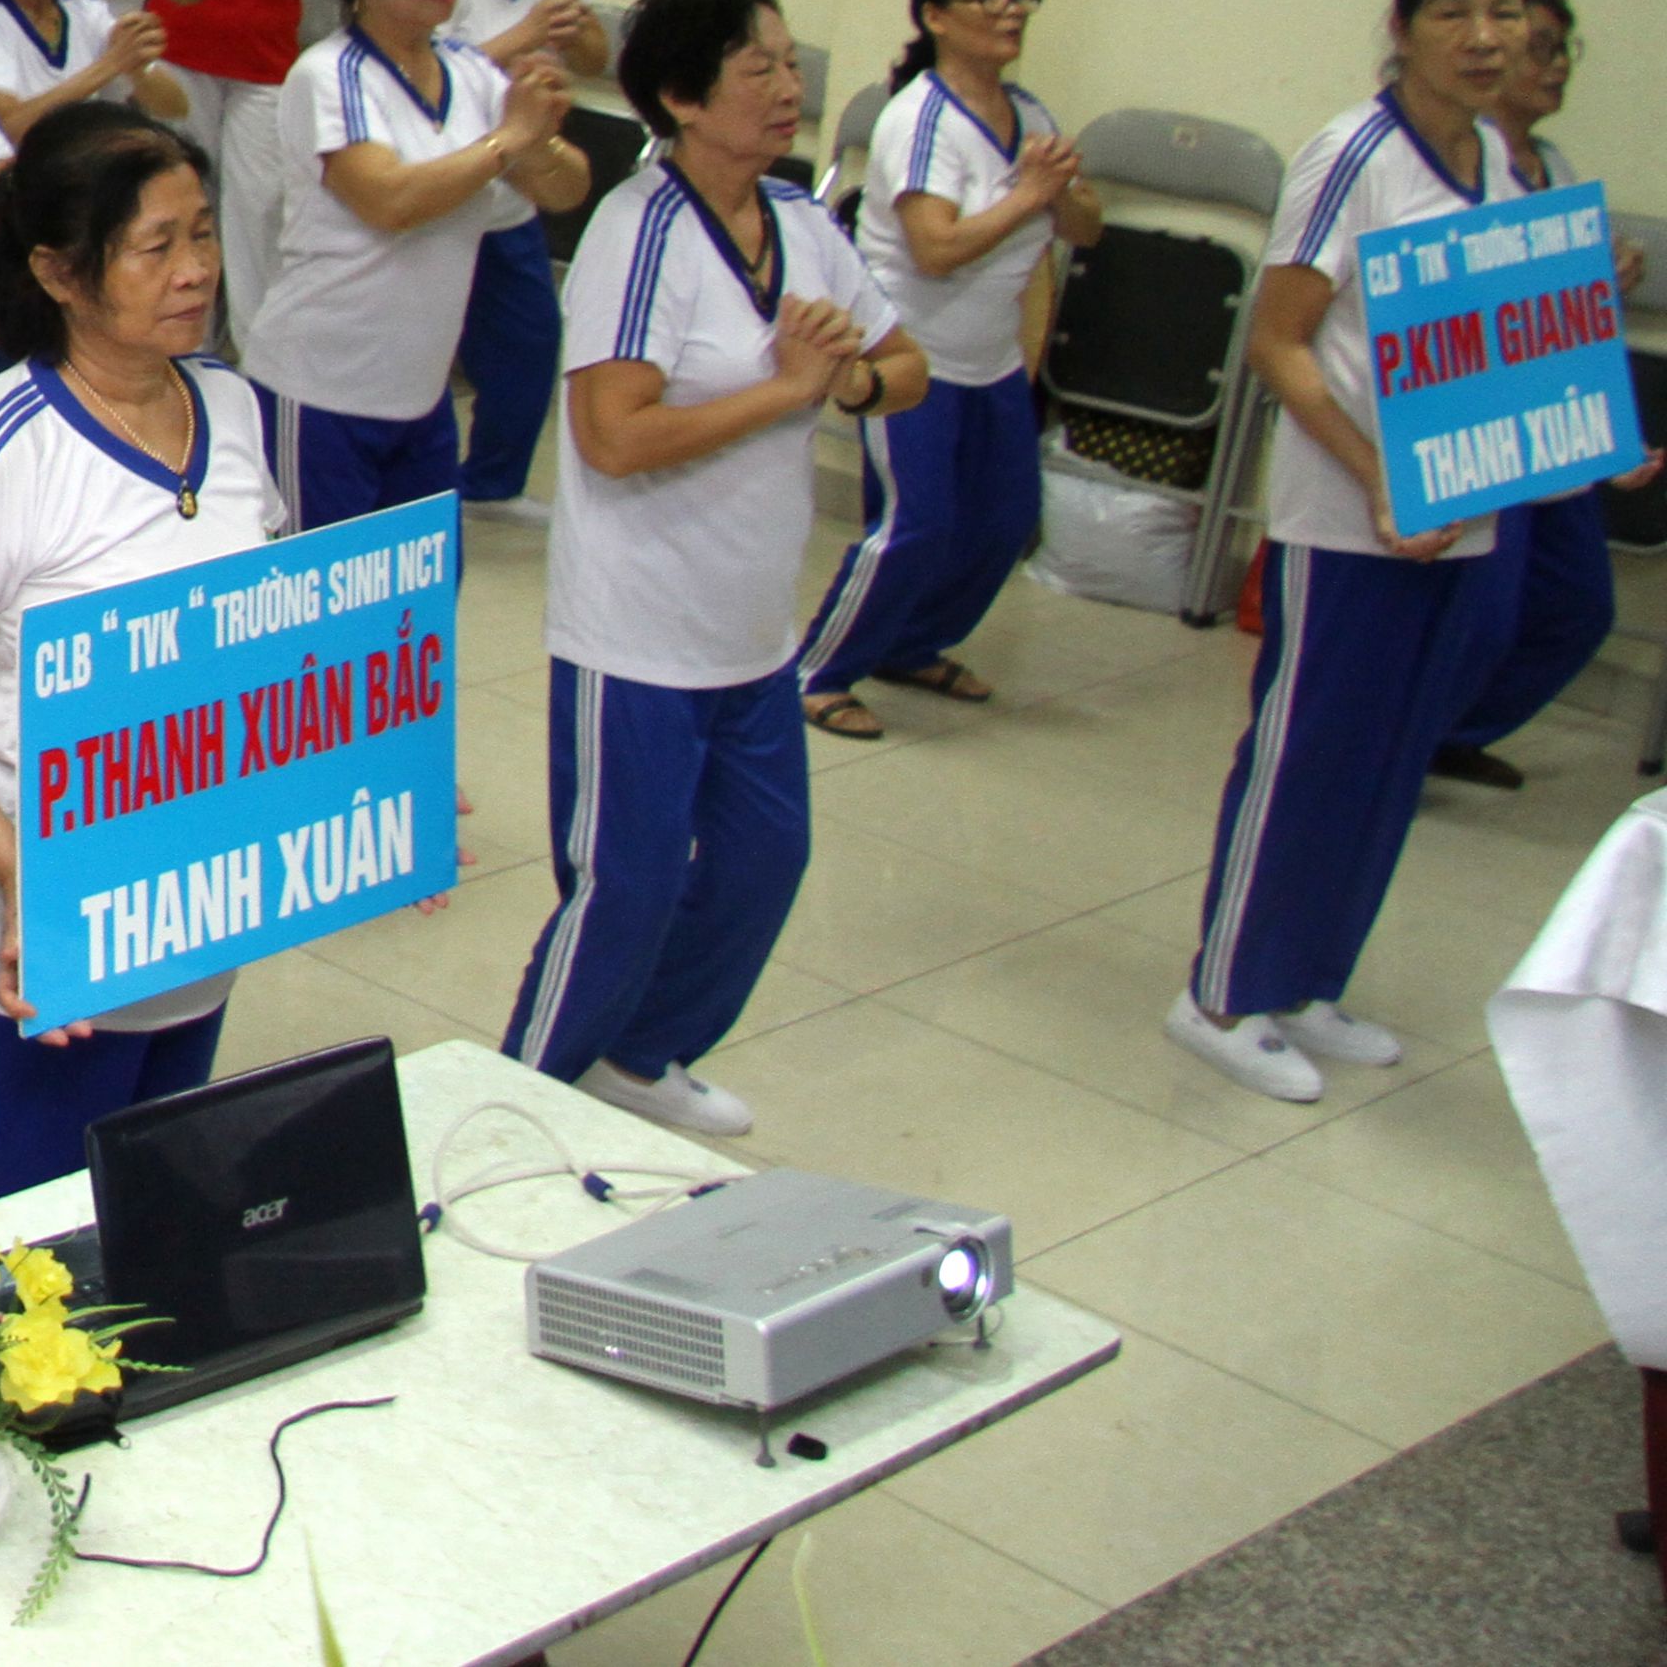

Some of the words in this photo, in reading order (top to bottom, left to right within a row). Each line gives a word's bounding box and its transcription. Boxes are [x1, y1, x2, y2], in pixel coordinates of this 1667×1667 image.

[1496, 278, 1620, 366] GIANG
[1412, 415, 1526, 505] THANH
[1524, 384, 1617, 474] XUÂN
[35, 632, 93, 700] CLB
[211, 566, 322, 649] TRƯỜNG
[327, 547, 392, 616] SINH
[397, 530, 447, 595] NCT
[238, 652, 354, 778] XUÂN
[365, 607, 444, 737] BẮC
[79, 843, 263, 984] THANH
[276, 786, 414, 919] XUÂN
[242, 1197, 289, 1229] acer
